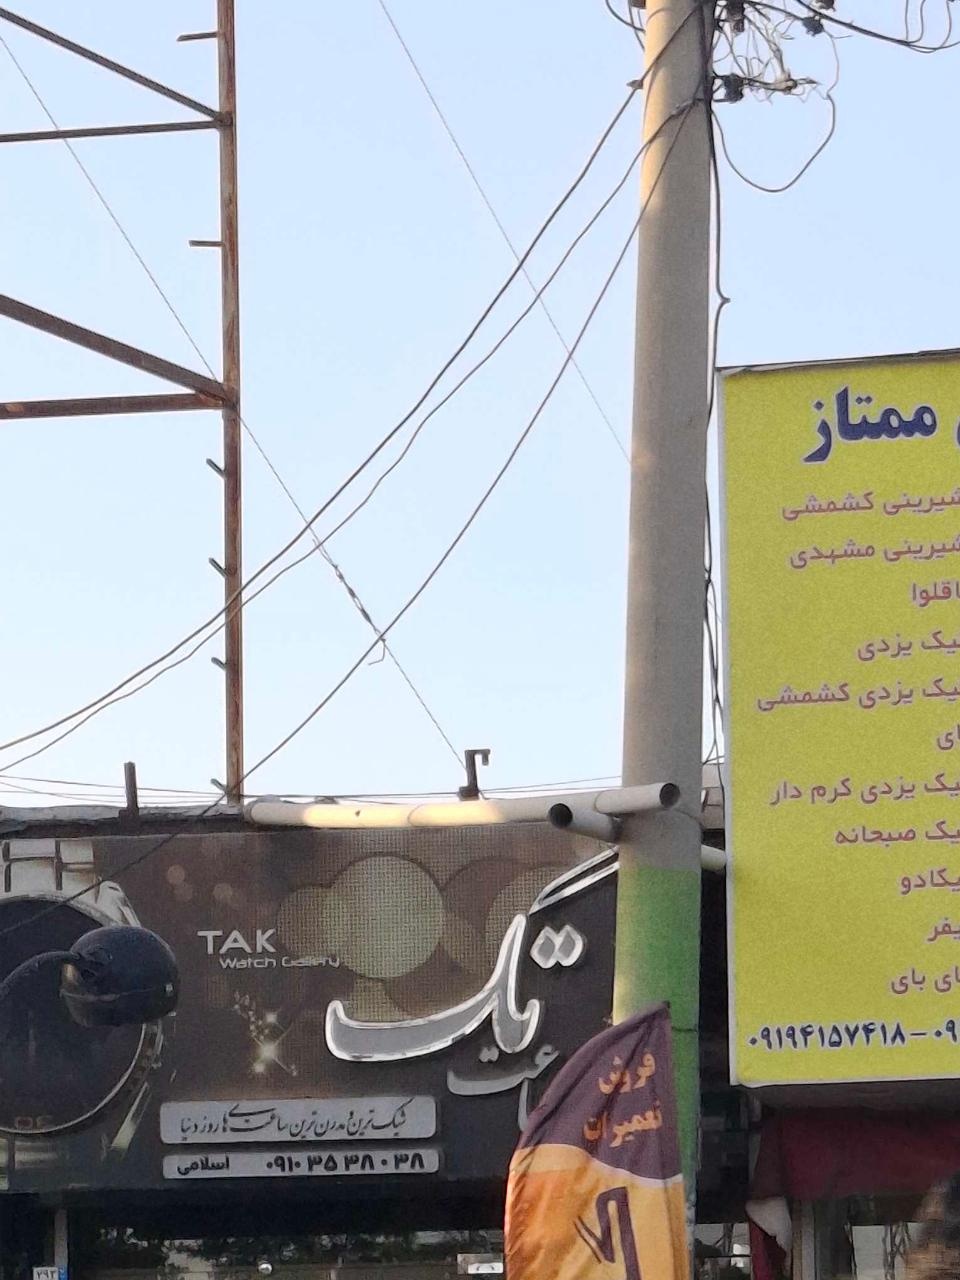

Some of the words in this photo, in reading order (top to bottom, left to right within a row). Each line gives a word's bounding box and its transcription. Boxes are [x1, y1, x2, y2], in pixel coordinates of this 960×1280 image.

[803, 385, 937, 462] ممتاز
[782, 491, 874, 521] کشمشی
[790, 539, 876, 570] مشهدی
[857, 634, 913, 662] یزدی
[757, 682, 850, 712] کشمشی
[858, 681, 914, 710] یزدی
[770, 781, 802, 806] دار
[810, 777, 852, 804] کرم
[860, 776, 916, 805] یزدی
[835, 825, 917, 847] صبحانه
[197, 929, 277, 954] TAK
[219, 956, 277, 969] Watch
[890, 968, 926, 995] بای
[177, 1152, 230, 1176] اسلامی
